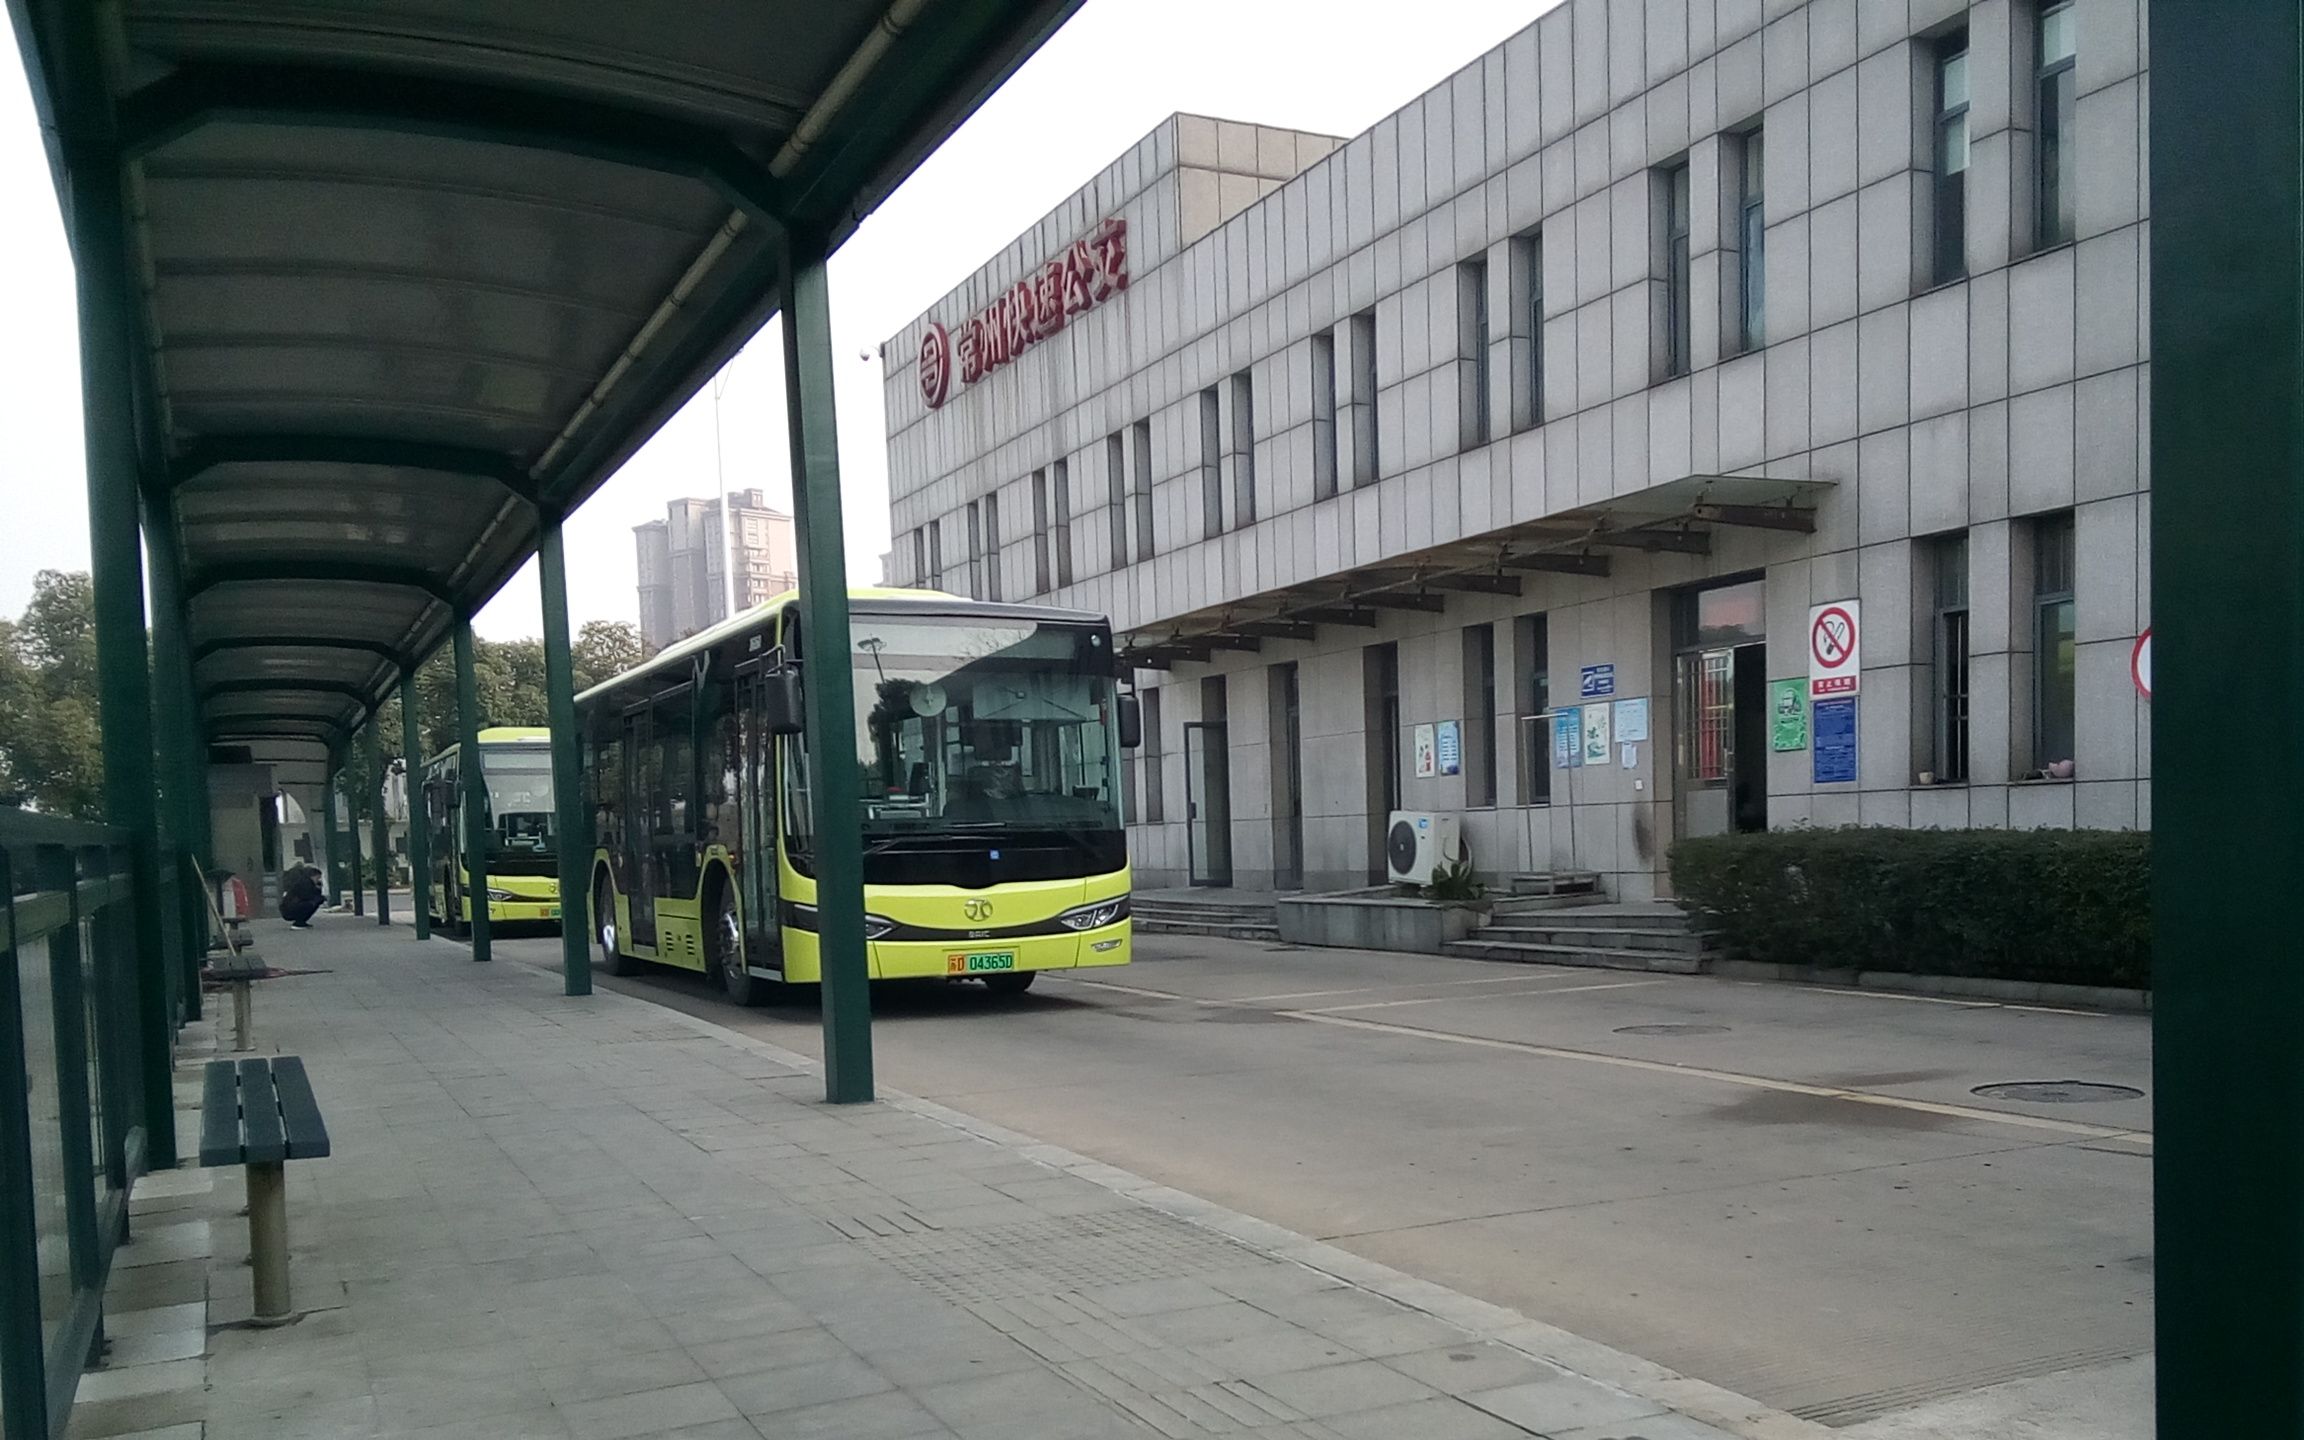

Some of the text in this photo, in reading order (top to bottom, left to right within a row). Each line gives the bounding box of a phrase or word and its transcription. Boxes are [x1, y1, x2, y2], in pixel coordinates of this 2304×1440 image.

[957, 218, 1129, 385] 常州快速公交
[969, 954, 1013, 971] 04365D
